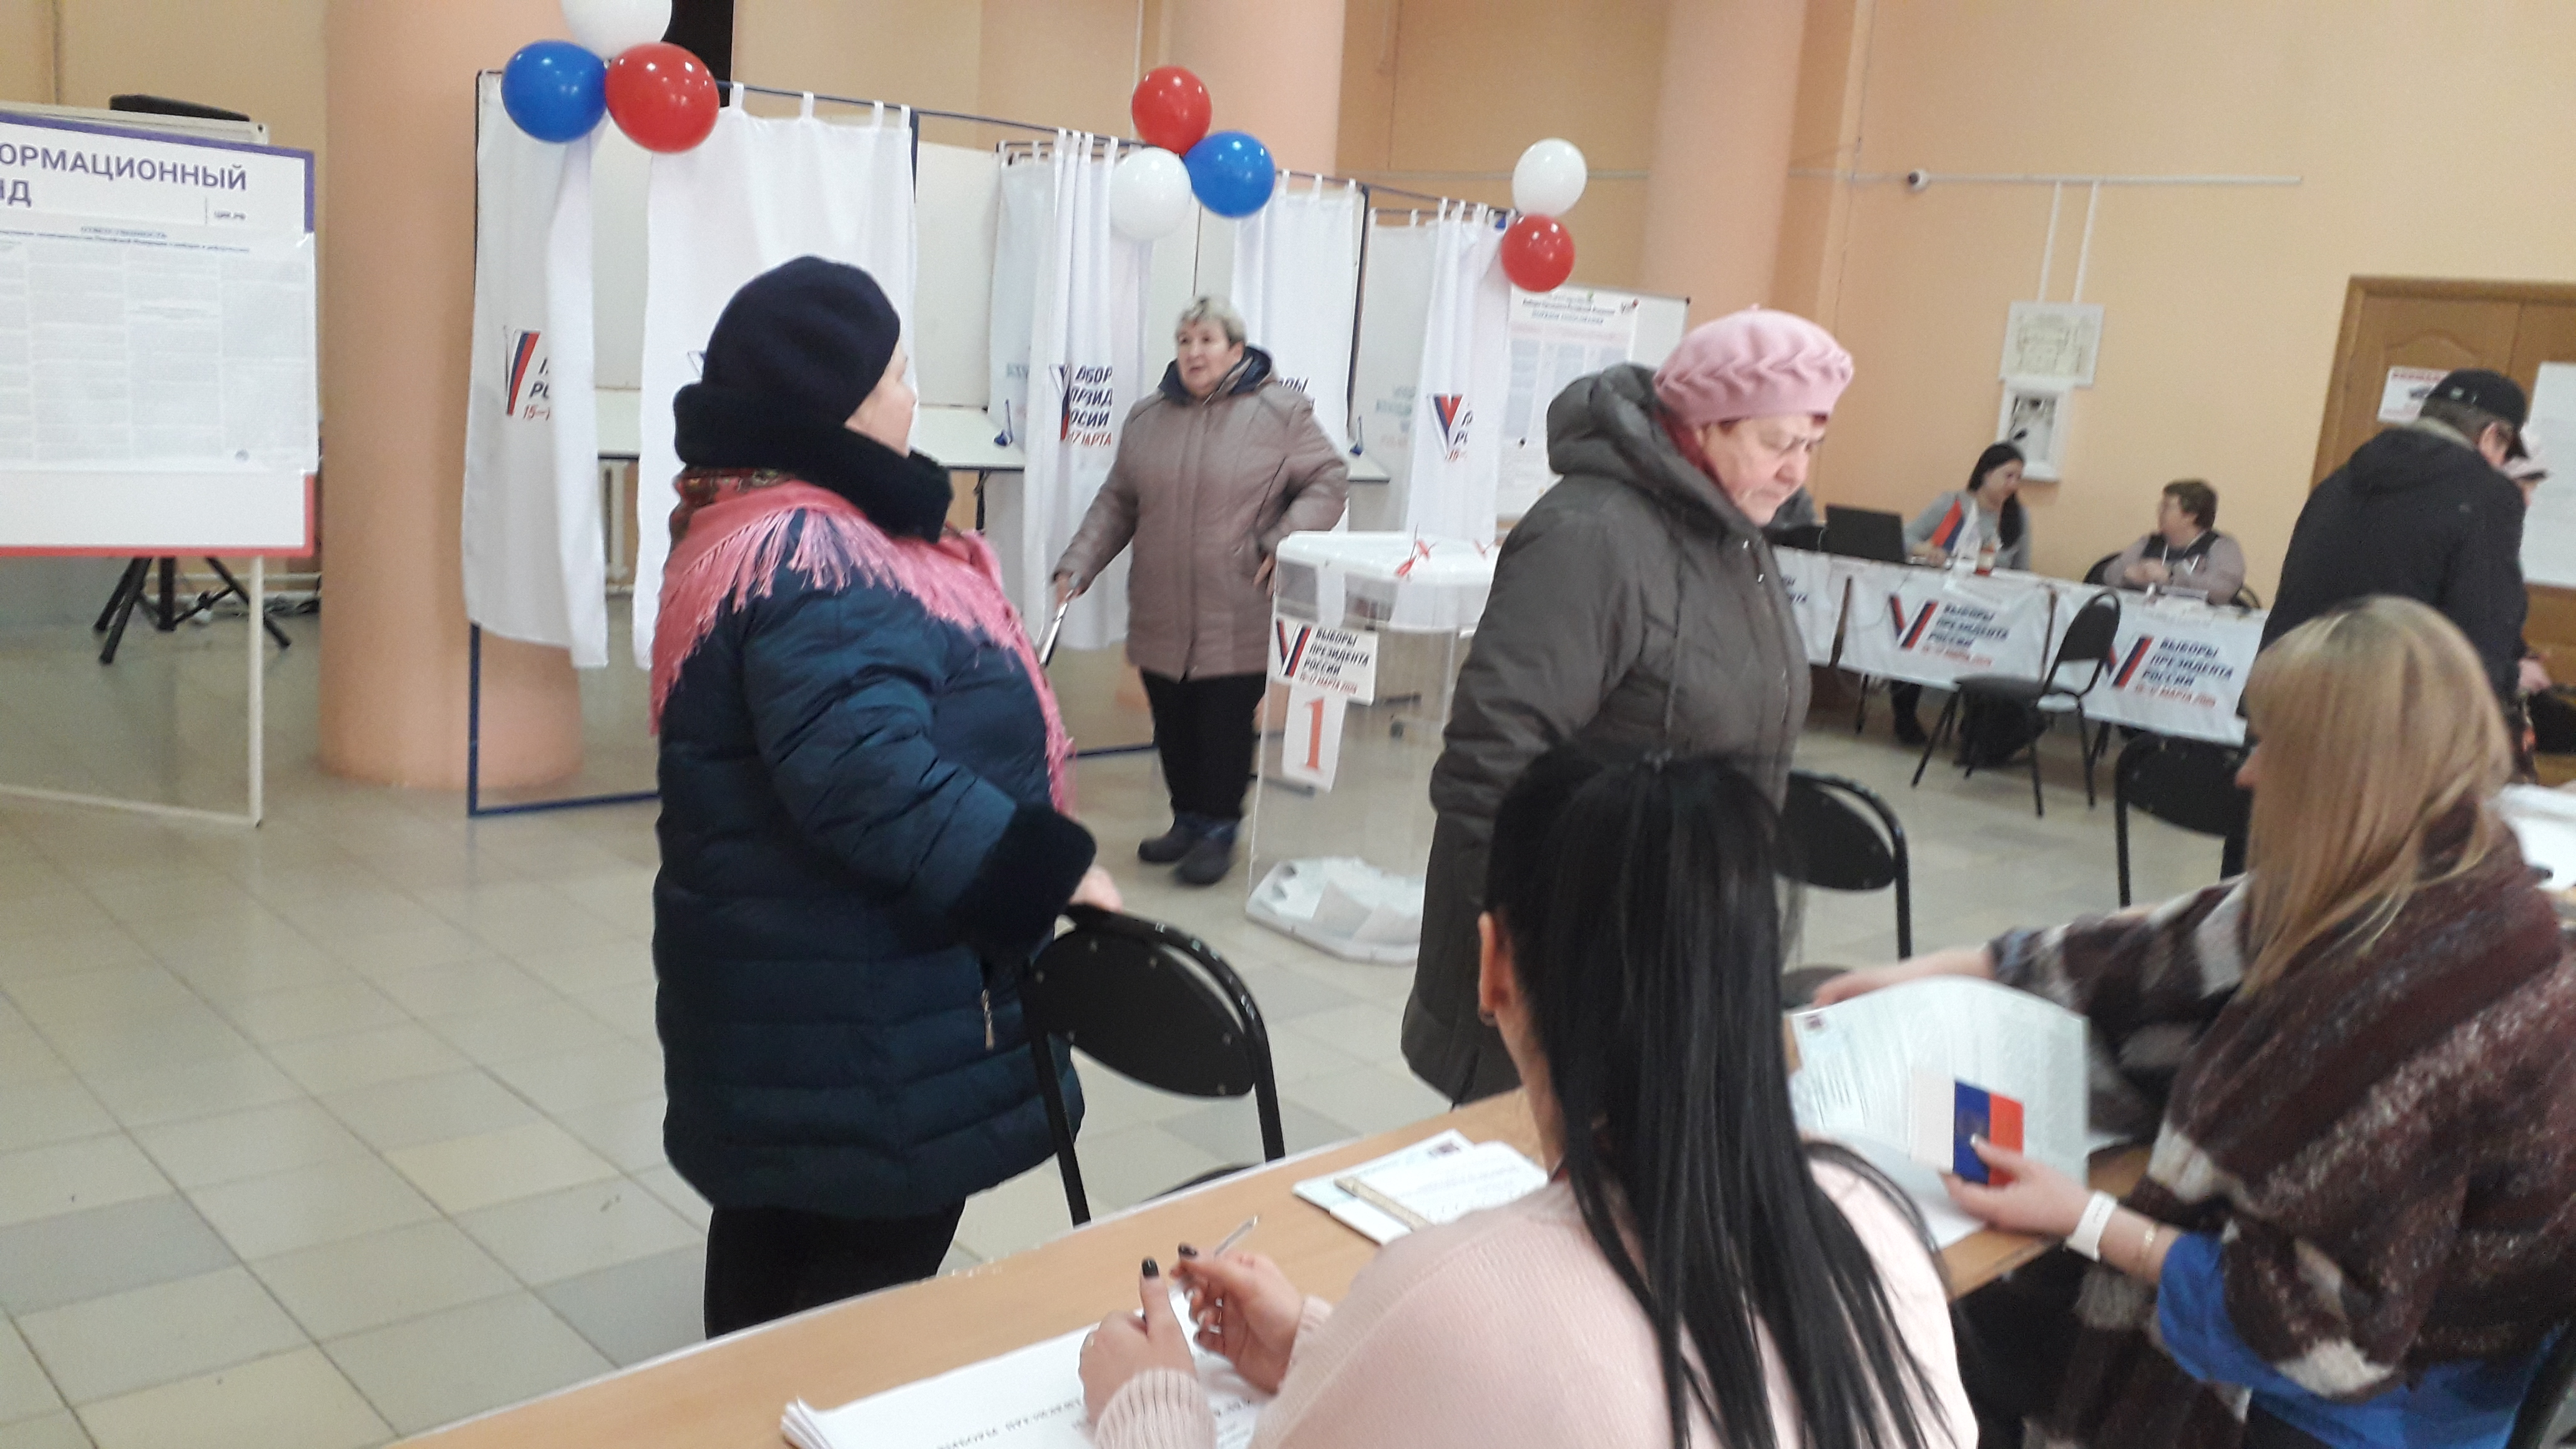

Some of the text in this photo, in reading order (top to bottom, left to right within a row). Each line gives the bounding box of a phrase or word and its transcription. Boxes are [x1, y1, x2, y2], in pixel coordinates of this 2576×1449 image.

[0, 142, 247, 190] ОРМАЦИОННЫЙ
[1315, 627, 1359, 647] ВЫБОРЫ
[2159, 637, 2220, 658] ВЫБОРЫ
[1309, 643, 1370, 667] ПРЕЗИДЕНТА
[1303, 658, 1342, 676] РОССИИ
[1303, 696, 1325, 774] 1
